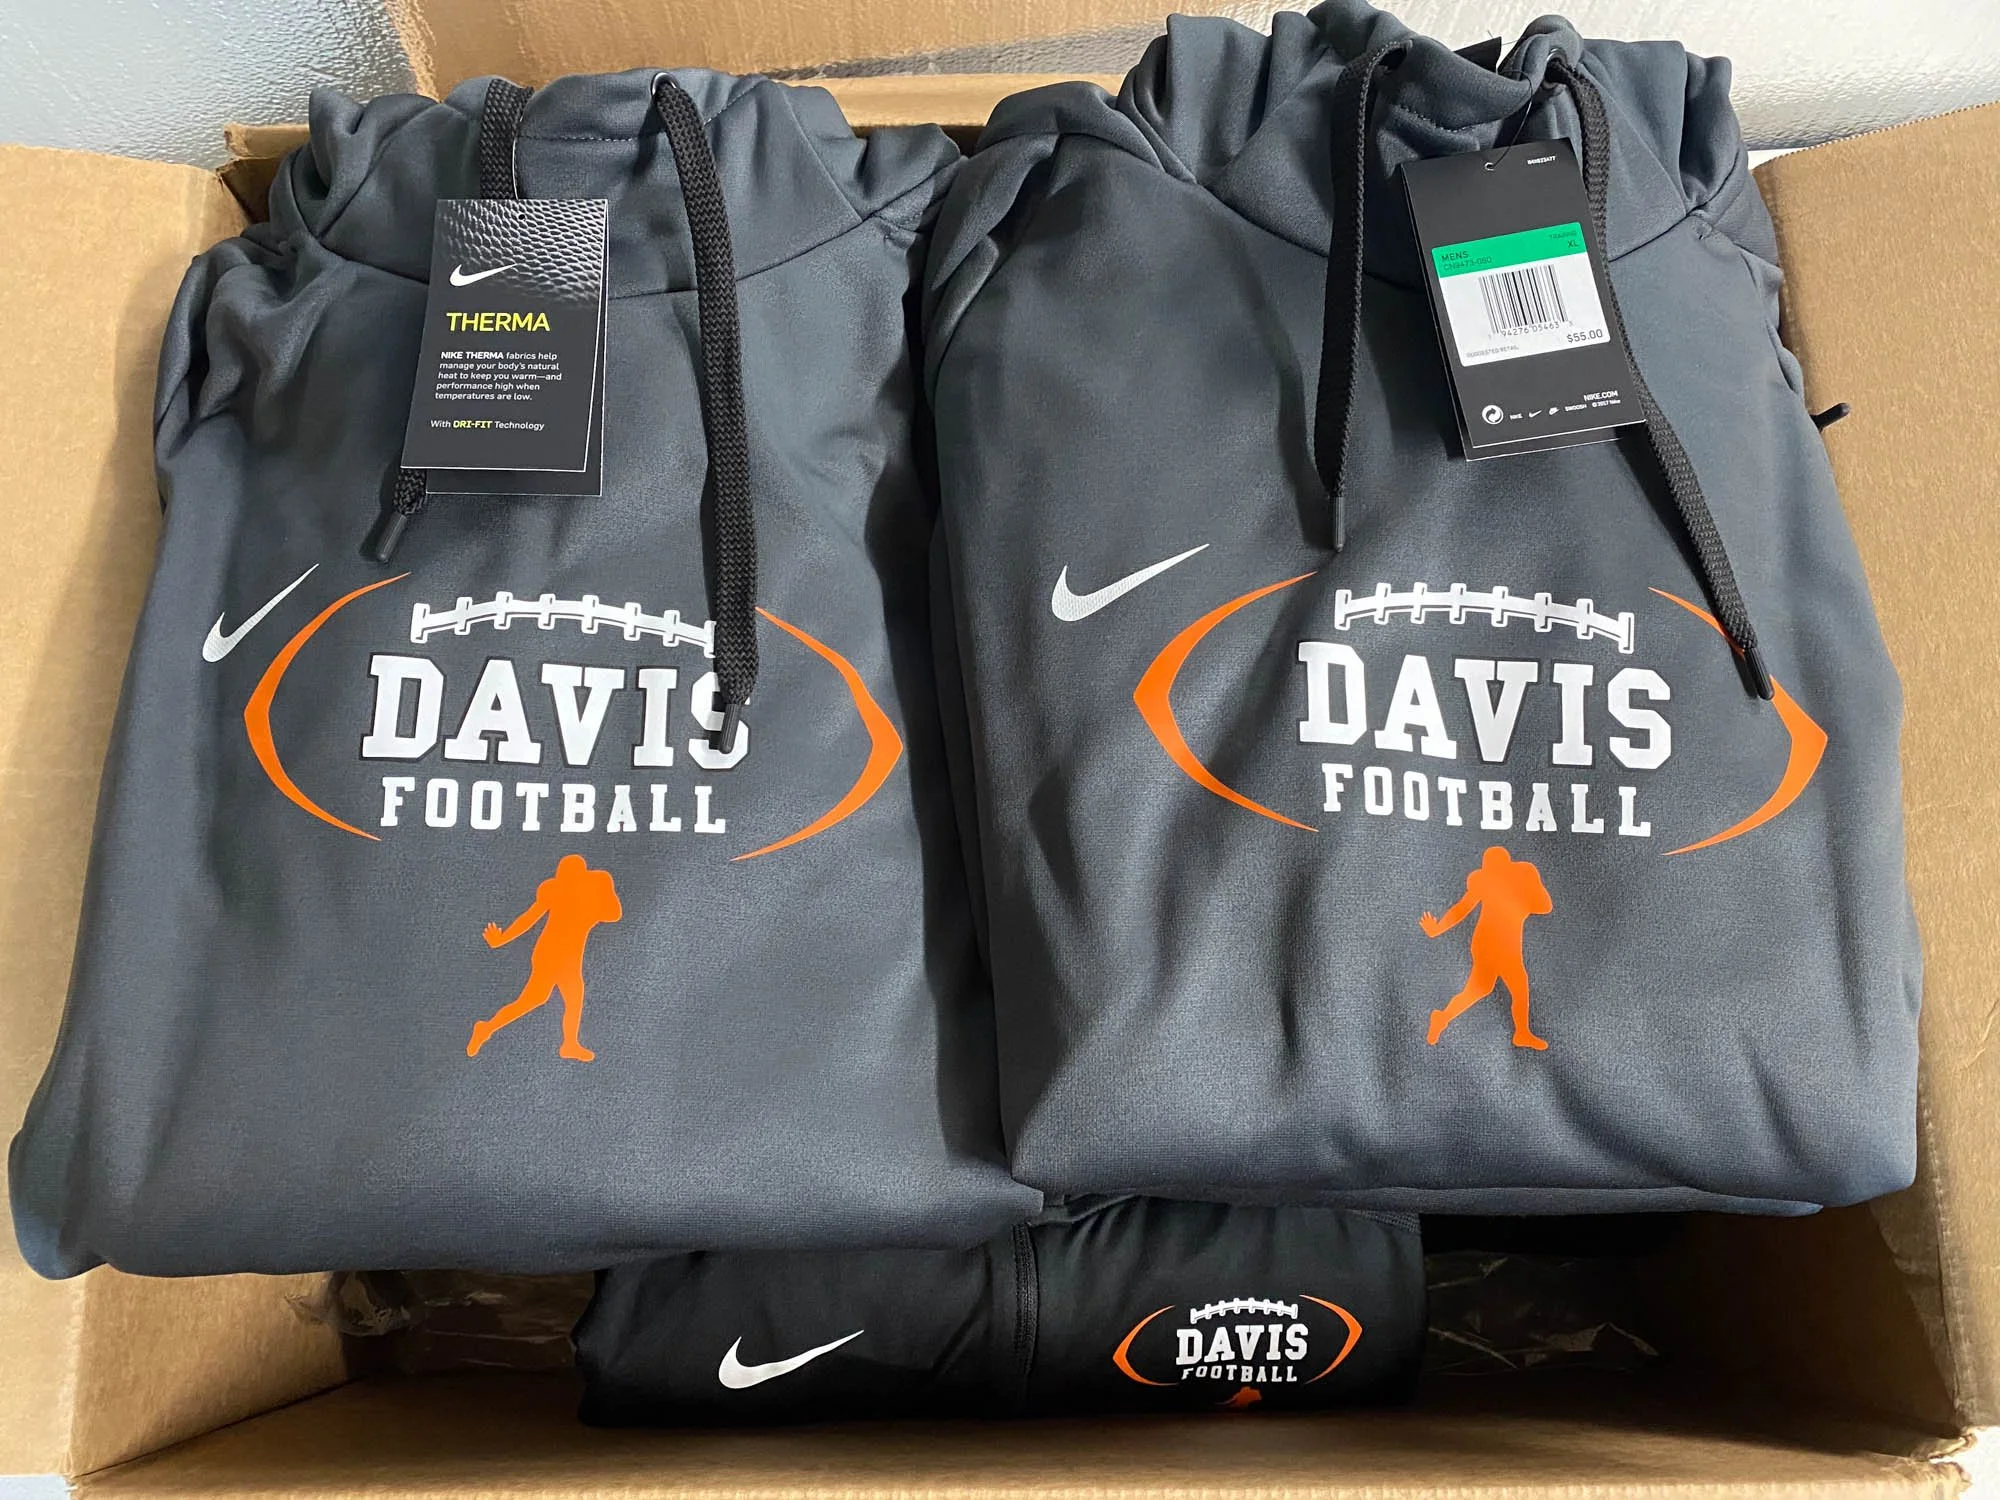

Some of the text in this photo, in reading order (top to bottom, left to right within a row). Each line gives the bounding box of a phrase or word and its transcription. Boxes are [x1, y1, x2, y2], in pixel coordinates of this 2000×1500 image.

[1567, 239, 1580, 249] XL
[1441, 250, 1469, 262] MENS
[446, 312, 550, 332] THERMA
[1501, 326, 1530, 337] 94276
[1566, 328, 1604, 343] $55.00
[440, 351, 558, 361] NIKE THERMA fabrics help
[439, 362, 560, 371] manage your body's natural
[437, 371, 458, 380] heat
[459, 372, 469, 380] to
[470, 371, 492, 381] keep
[493, 373, 510, 381] you
[436, 381, 541, 391] performance high when
[434, 391, 533, 401] temperatures are low.
[1583, 390, 1619, 401] NIKE.COM
[430, 419, 545, 432] With DRI-FIT Technology
[1297, 641, 1672, 770] DAVIS
[361, 654, 751, 770] DAVIS
[380, 776, 727, 835] FOOTBALL
[1321, 762, 1652, 838] FOOTBALL
[1175, 1323, 1309, 1366] DAVIS
[1181, 1365, 1298, 1383] FOOTBALL
